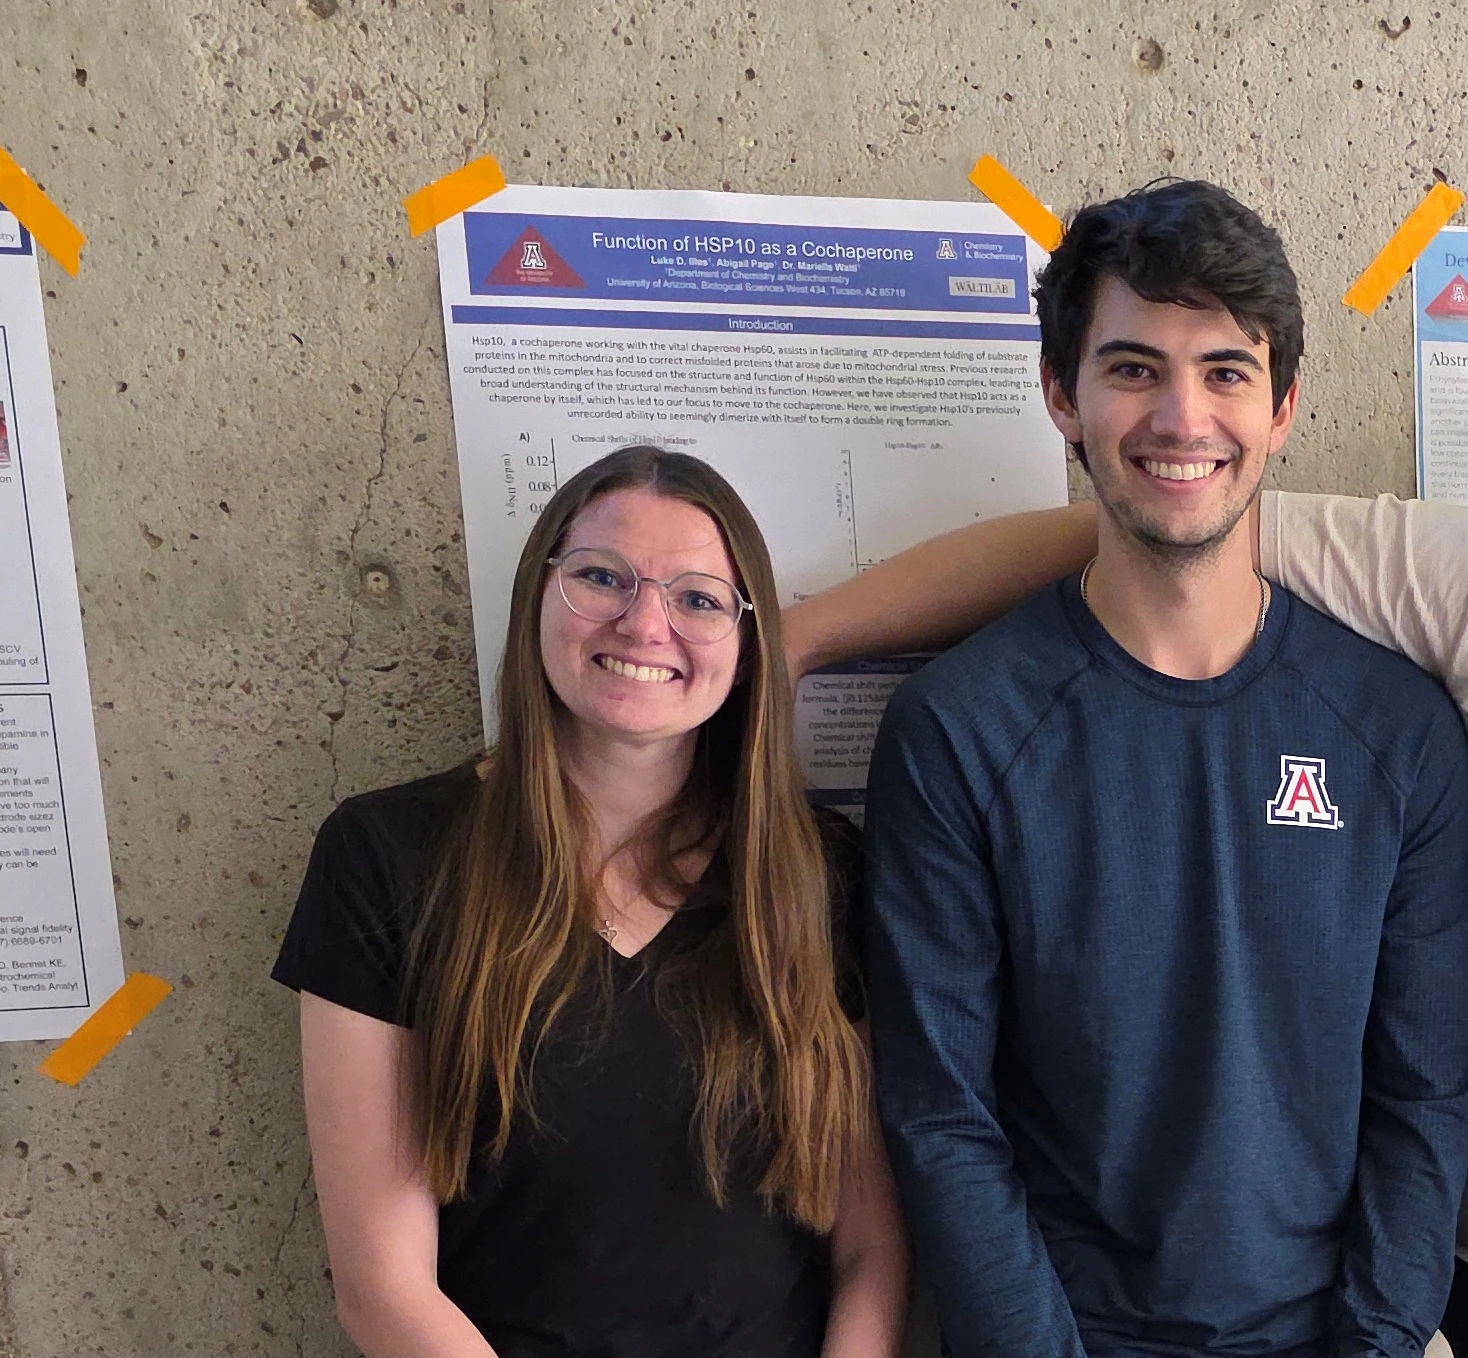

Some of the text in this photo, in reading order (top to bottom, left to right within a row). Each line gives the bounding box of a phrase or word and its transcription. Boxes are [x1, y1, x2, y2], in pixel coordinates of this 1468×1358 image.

[592, 232, 913, 260] Function of HSP10 as a Cochaperone
[651, 256, 674, 266] Luke
[782, 261, 795, 269] Dr.
[728, 318, 793, 332] Introduction
[472, 336, 505, 346] Hsp10,
[520, 338, 582, 347] cochaperone
[585, 340, 624, 350] working
[626, 341, 647, 349] with
[650, 341, 665, 350] the
[668, 342, 688, 350] vital
[691, 343, 740, 353] chaperone
[743, 345, 775, 354] Hsp60,
[778, 346, 807, 354] assists
[820, 347, 868, 358] facilitating
[872, 349, 941, 359] ATP-dependent
[943, 350, 974, 361] folding
[976, 351, 985, 360] of
[987, 352, 1027, 360] substrate
[475, 352, 515, 360] proteins
[518, 352, 527, 360] in
[529, 352, 545, 360] the
[548, 353, 613, 362] mitochondria
[616, 355, 634, 363] and
[685, 356, 731, 366] misfolded
[734, 359, 772, 367] proteins
[774, 359, 793, 368] that
[823, 360, 840, 369] due
[842, 362, 852, 370] to
[854, 362, 917, 371] mitochondrial
[950, 364, 988, 373] Previous
[990, 366, 1027, 374] research
[463, 365, 515, 373] conducted
[533, 366, 550, 374] this
[553, 367, 593, 376] complex
[596, 367, 613, 376] has
[616, 368, 652, 377] focused
[670, 370, 686, 378] the
[734, 372, 751, 380] and
[754, 372, 792, 381] function
[794, 373, 803, 382] of
[806, 374, 835, 383] Hsp60
[868, 375, 883, 384] the
[885, 376, 945, 386] Hsp60-Hsp10
[989, 378, 1020, 389] leading
[519, 432, 530, 443] A)
[526, 455, 549, 467] 0.12
[528, 481, 552, 492] 0.08
[29, 656, 39, 666] of
[0, 730, 49, 739] pamine in
[1267, 754, 1339, 831] A
[33, 800, 60, 809] much
[26, 825, 51, 834] open
[14, 847, 57, 857] will need
[26, 860, 39, 868] be
[11, 925, 39, 936] signal
[0, 971, 56, 981] trochemical
[13, 984, 46, 993] Trends
